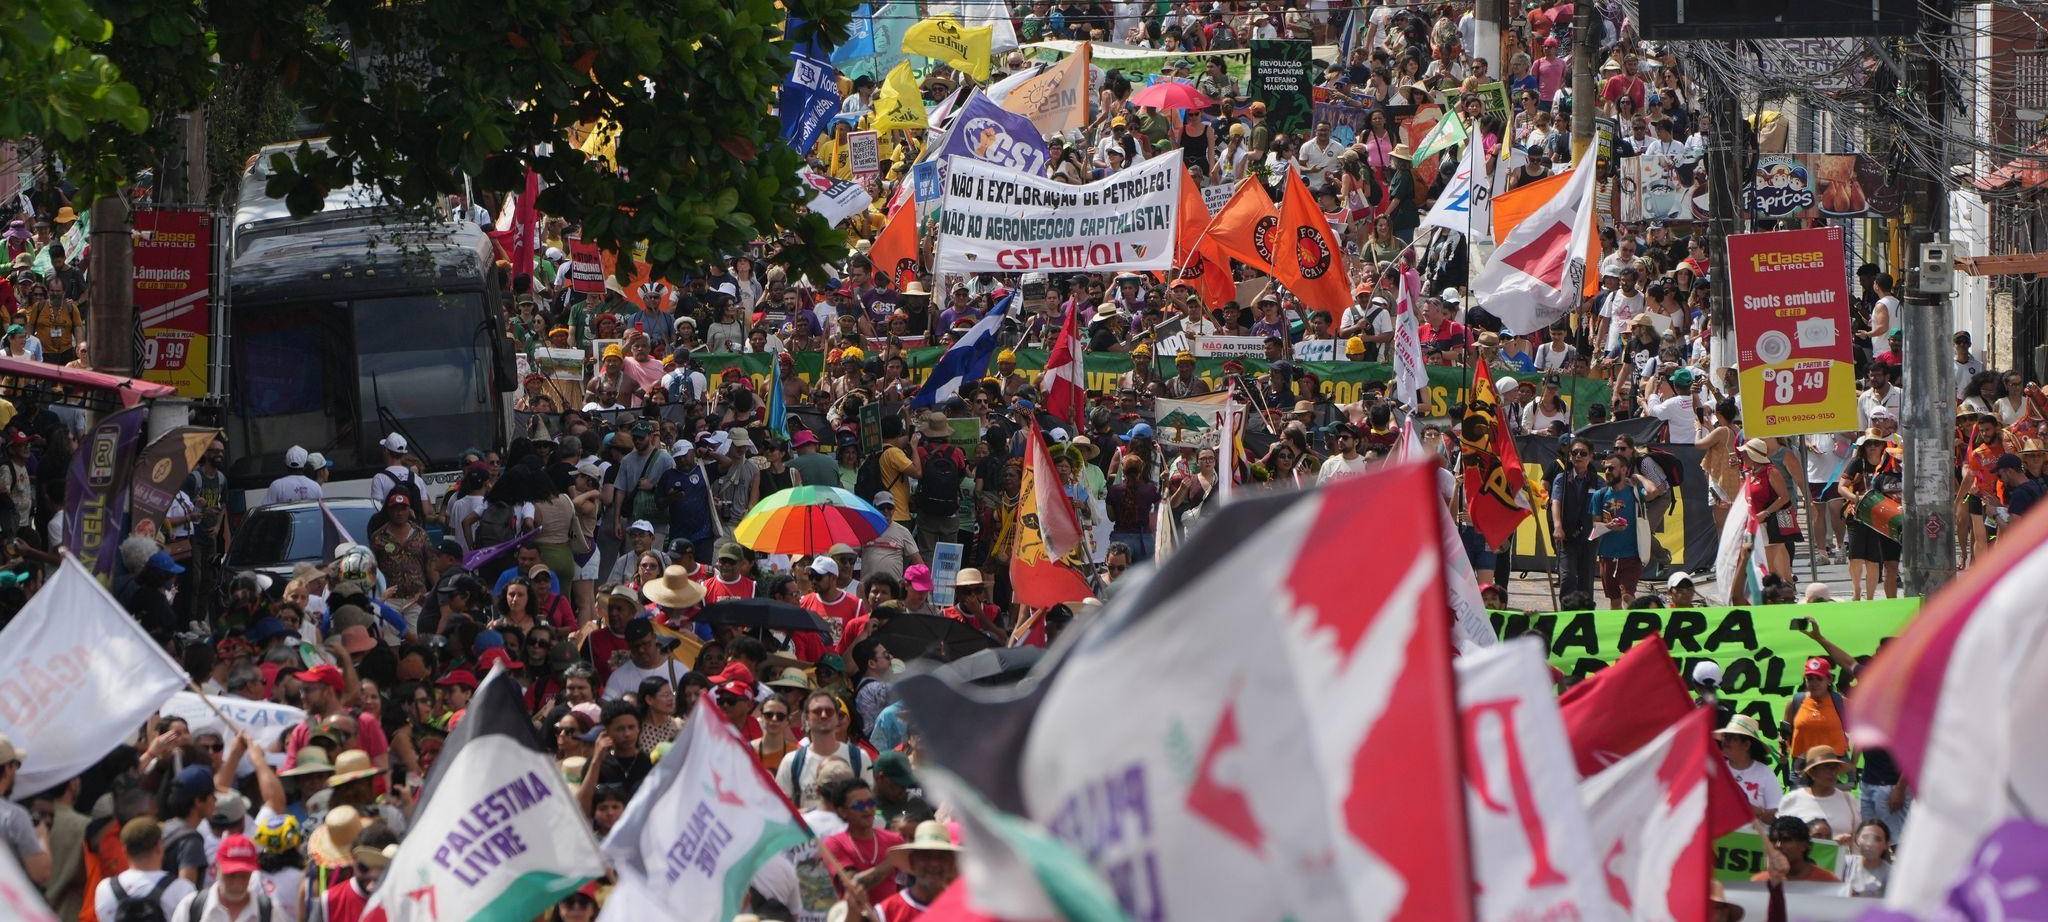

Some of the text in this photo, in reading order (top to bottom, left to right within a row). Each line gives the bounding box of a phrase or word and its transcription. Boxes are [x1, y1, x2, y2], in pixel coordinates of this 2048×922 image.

[951, 173, 973, 198] NÃO
[1083, 192, 1100, 206] DE
[1103, 168, 1172, 203] PETRÓLEO!
[941, 208, 964, 236] NÃO
[967, 214, 982, 239] AO
[1080, 204, 1170, 237] CAPITALISTA!
[132, 265, 191, 281] Lâmpadas
[1759, 262, 1824, 272] ELETROLED
[1744, 289, 1836, 310] Spots embutir
[1202, 342, 1222, 350] NÃO
[1616, 609, 1759, 654] PRA
[432, 770, 552, 870] PALESTINA
[453, 823, 528, 887] LIVRE
